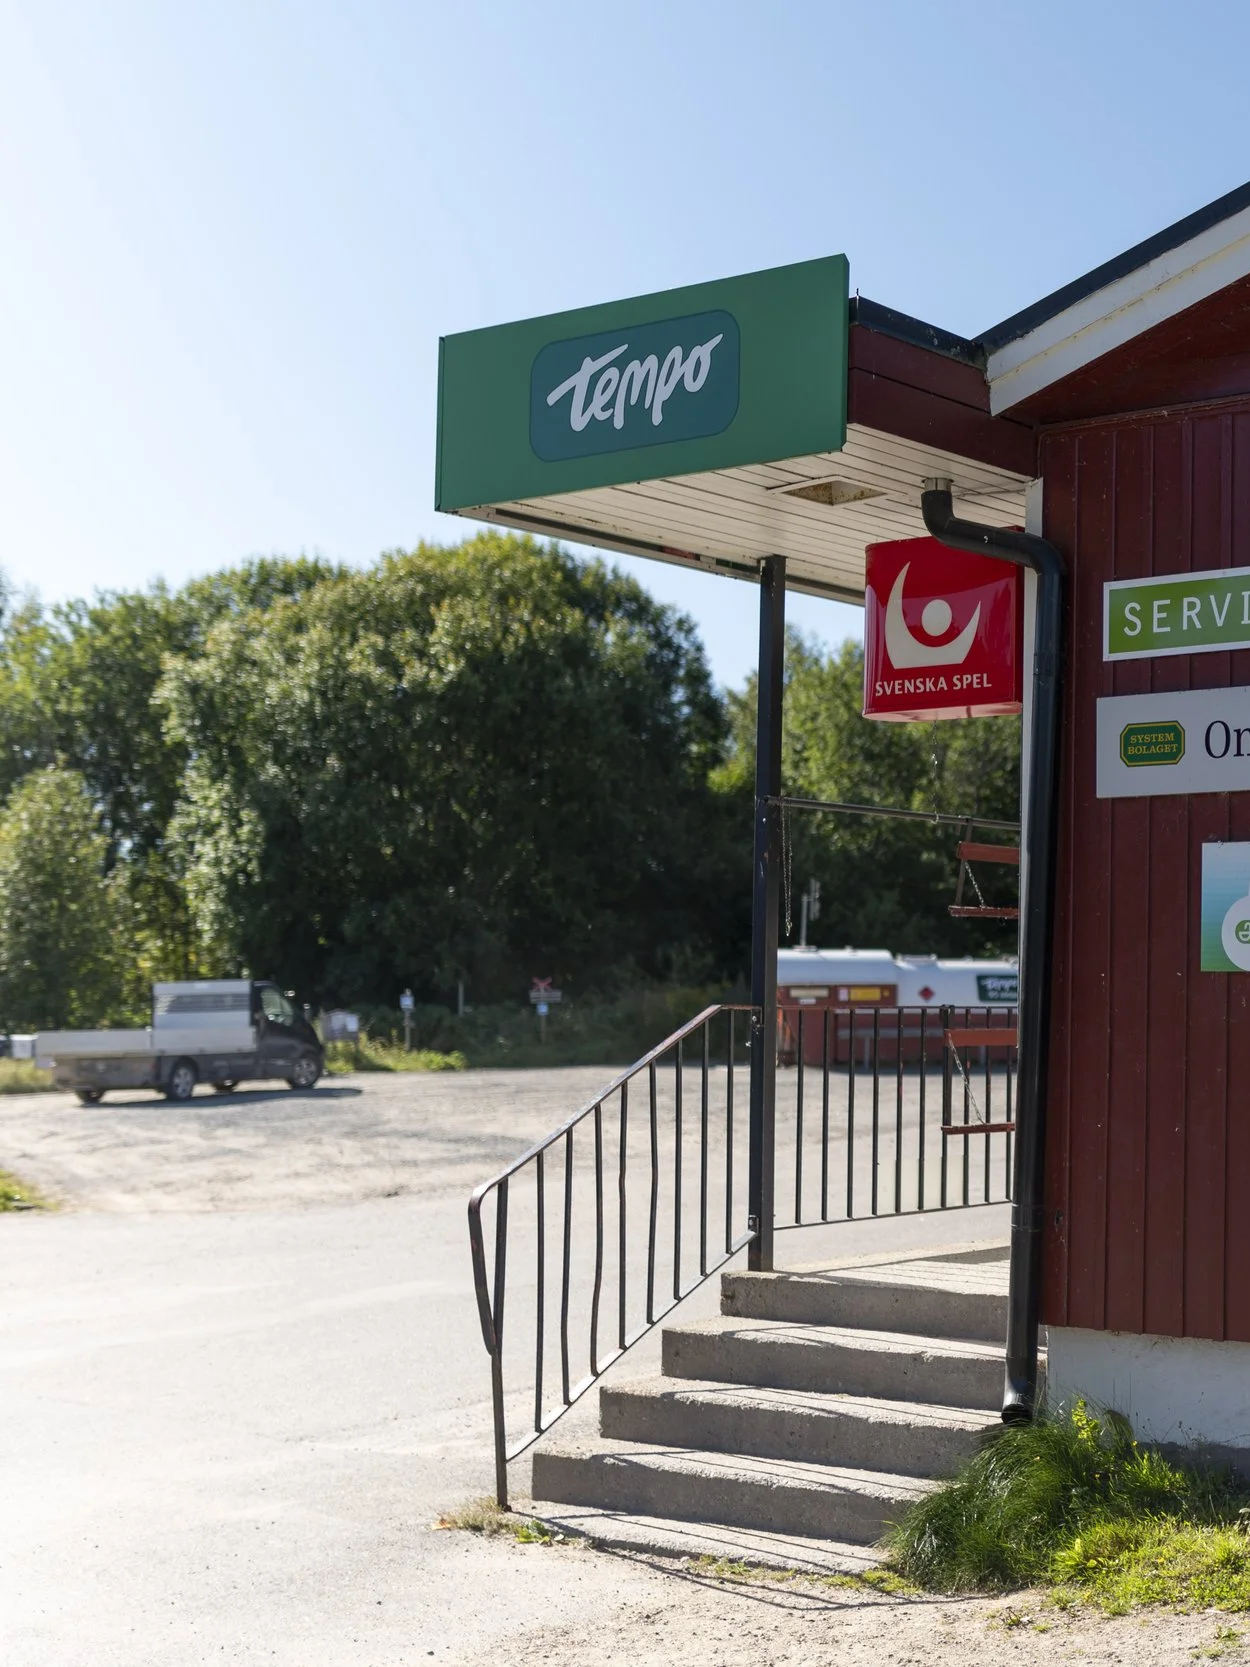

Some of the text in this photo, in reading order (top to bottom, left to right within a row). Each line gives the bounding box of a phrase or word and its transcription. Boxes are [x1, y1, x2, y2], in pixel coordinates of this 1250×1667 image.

[875, 672, 993, 697] SVENSKA SPEL
[1130, 732, 1175, 744] SYSTEM
[1127, 743, 1179, 755] BOLAGET
